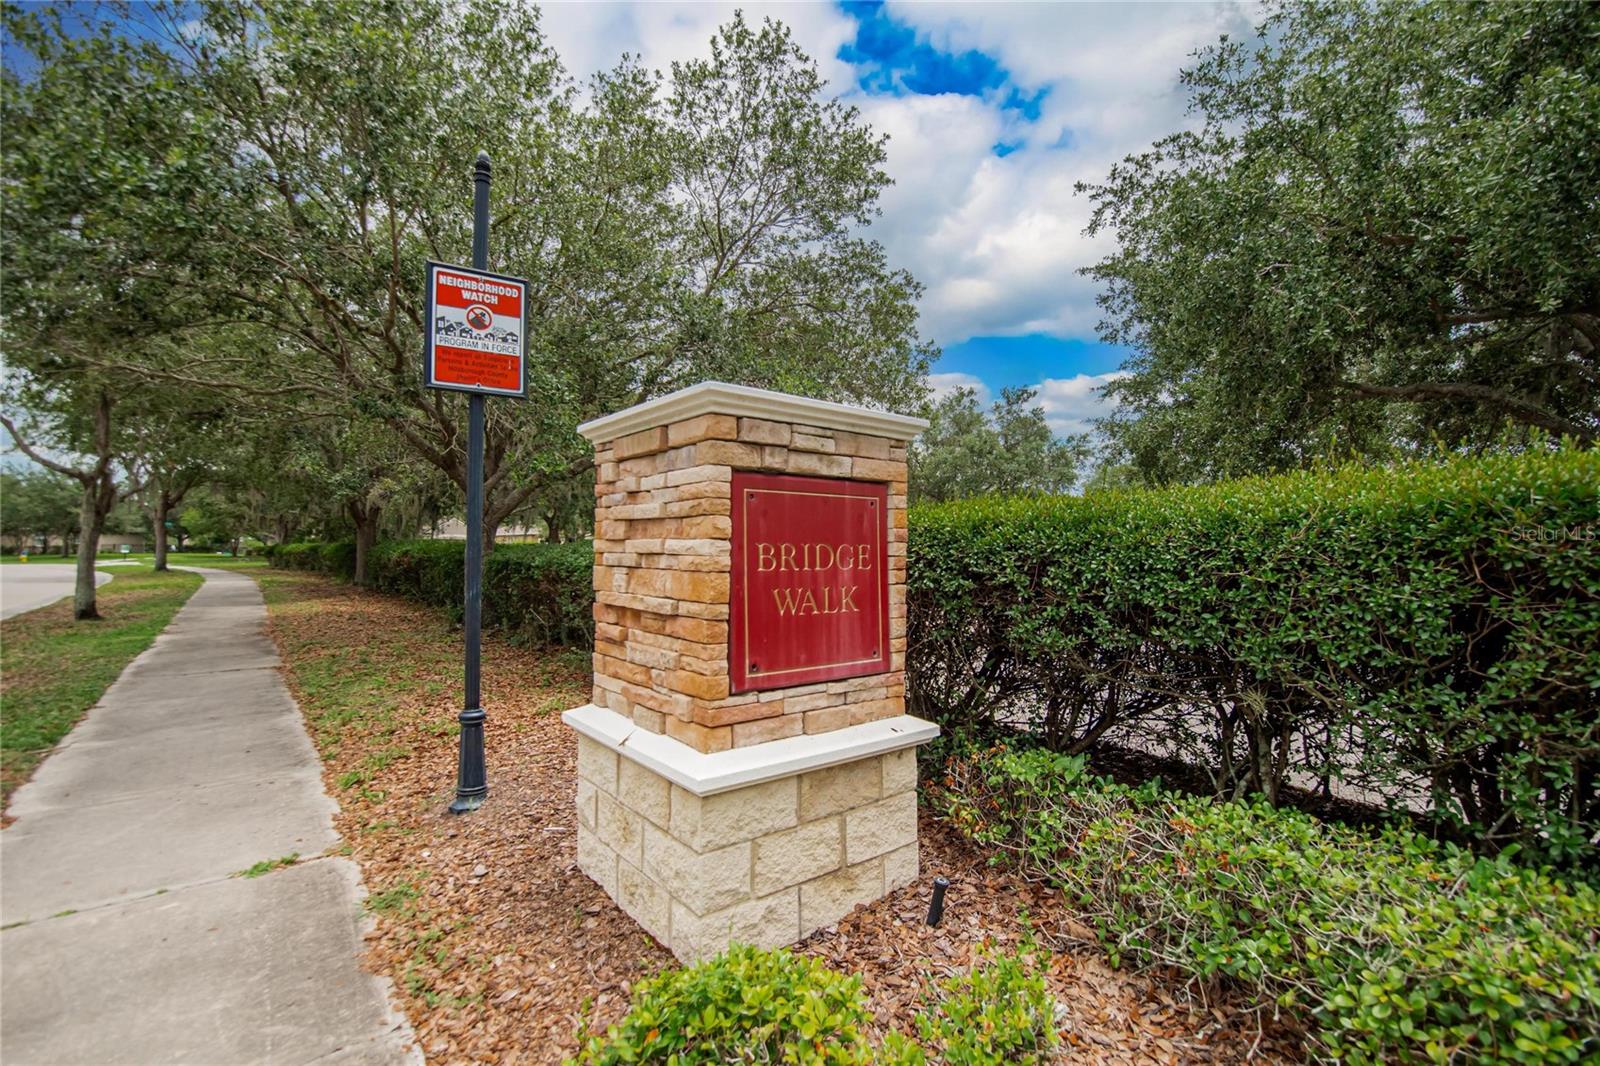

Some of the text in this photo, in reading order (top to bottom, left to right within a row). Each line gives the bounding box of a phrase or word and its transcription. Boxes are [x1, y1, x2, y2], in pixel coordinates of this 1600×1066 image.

[439, 275, 519, 297] NEIGHBORHOOD
[461, 290, 499, 304] WATCH
[439, 336, 517, 355] PROGRAM IN FORCE
[755, 543, 872, 572] BRIDGE
[772, 585, 861, 616] WALK
